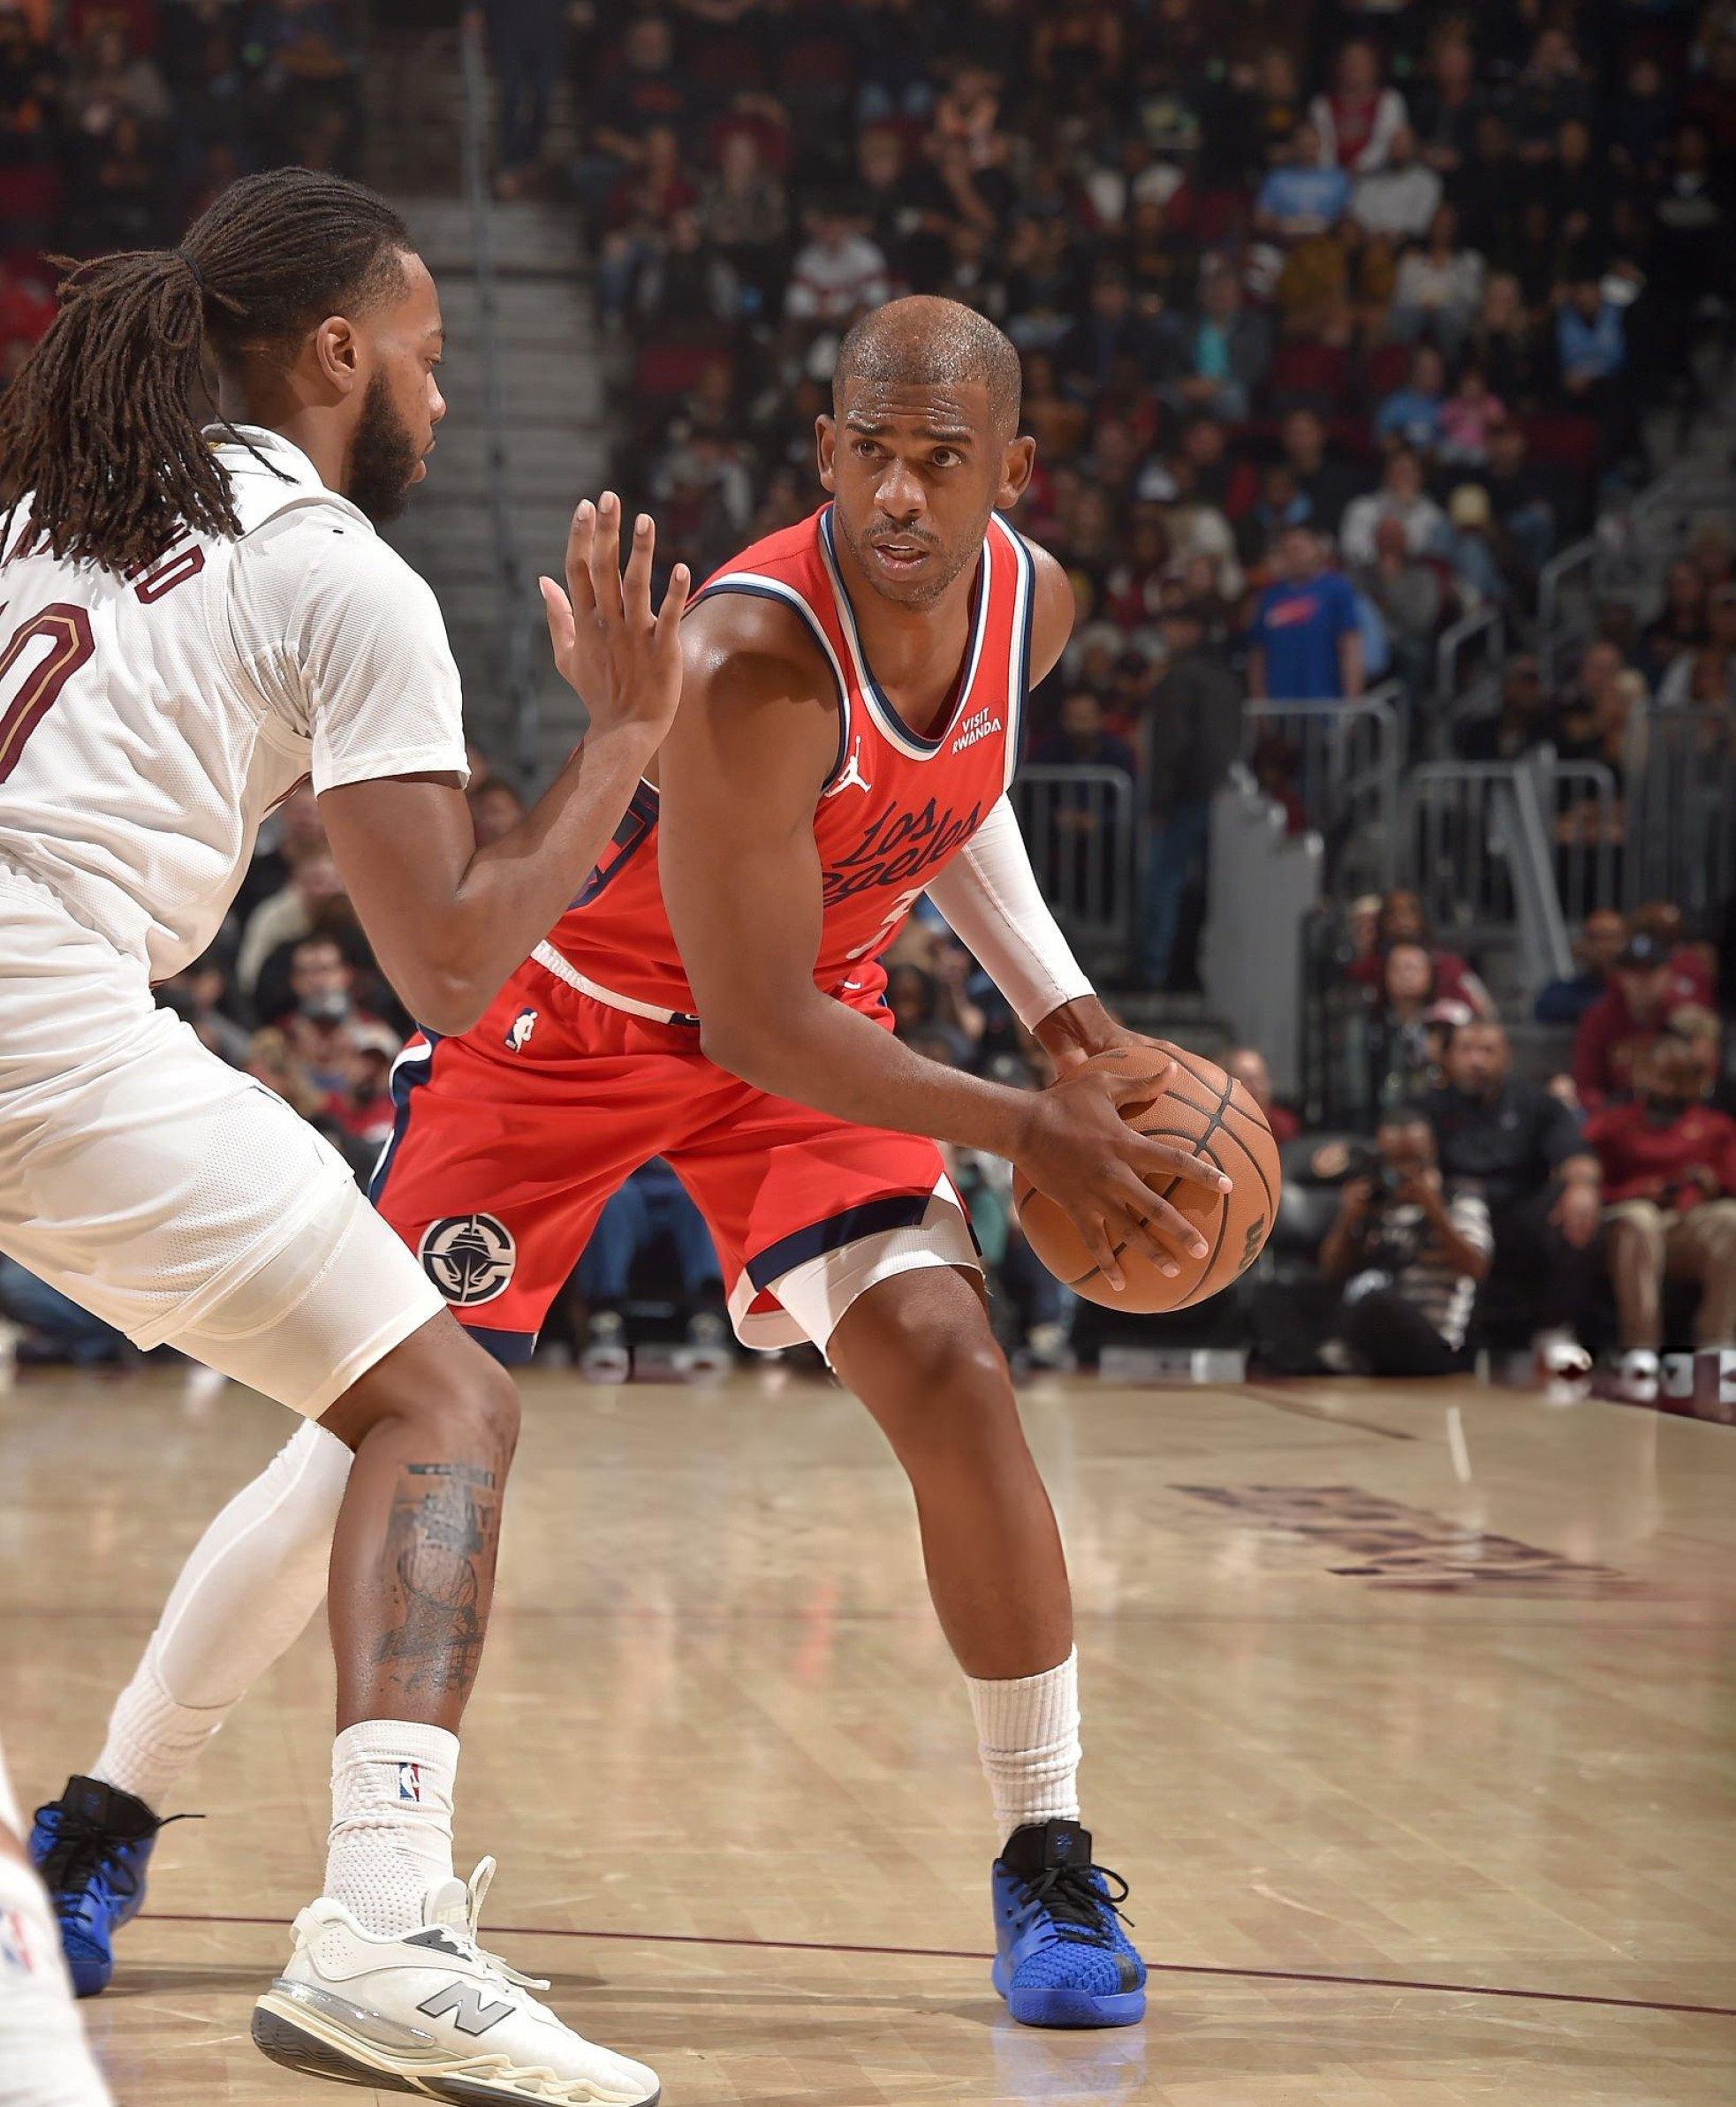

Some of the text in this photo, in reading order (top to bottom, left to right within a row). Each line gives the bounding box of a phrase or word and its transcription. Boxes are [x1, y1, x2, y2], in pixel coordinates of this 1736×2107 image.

[0, 602, 95, 784] 0
[951, 717, 1002, 755] RWANDA
[961, 707, 989, 734] VISIT
[831, 797, 938, 868] Los
